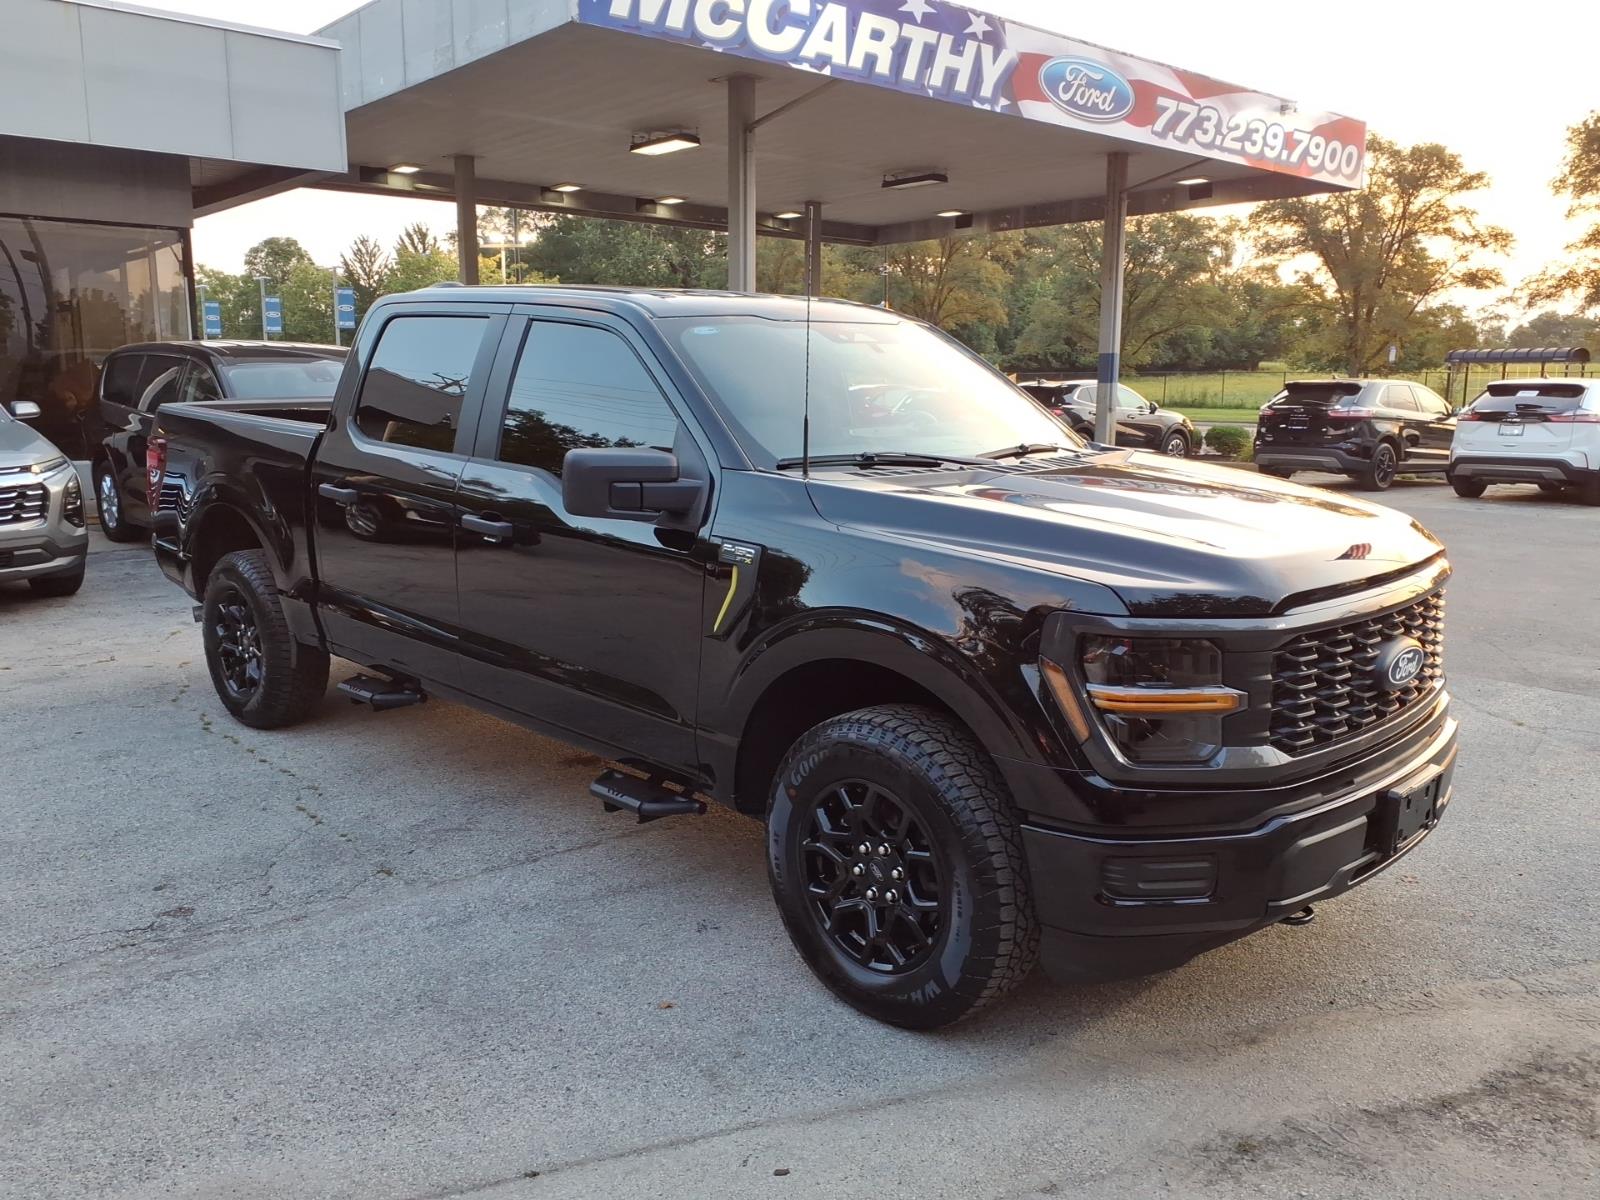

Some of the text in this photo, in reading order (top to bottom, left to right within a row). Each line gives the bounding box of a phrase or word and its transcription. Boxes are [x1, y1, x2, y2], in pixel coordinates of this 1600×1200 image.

[608, 0, 1019, 97] cCARTHY
[1058, 64, 1117, 112] Ford
[1151, 96, 1360, 176] 773.239.7900
[1395, 651, 1419, 679] Ford
